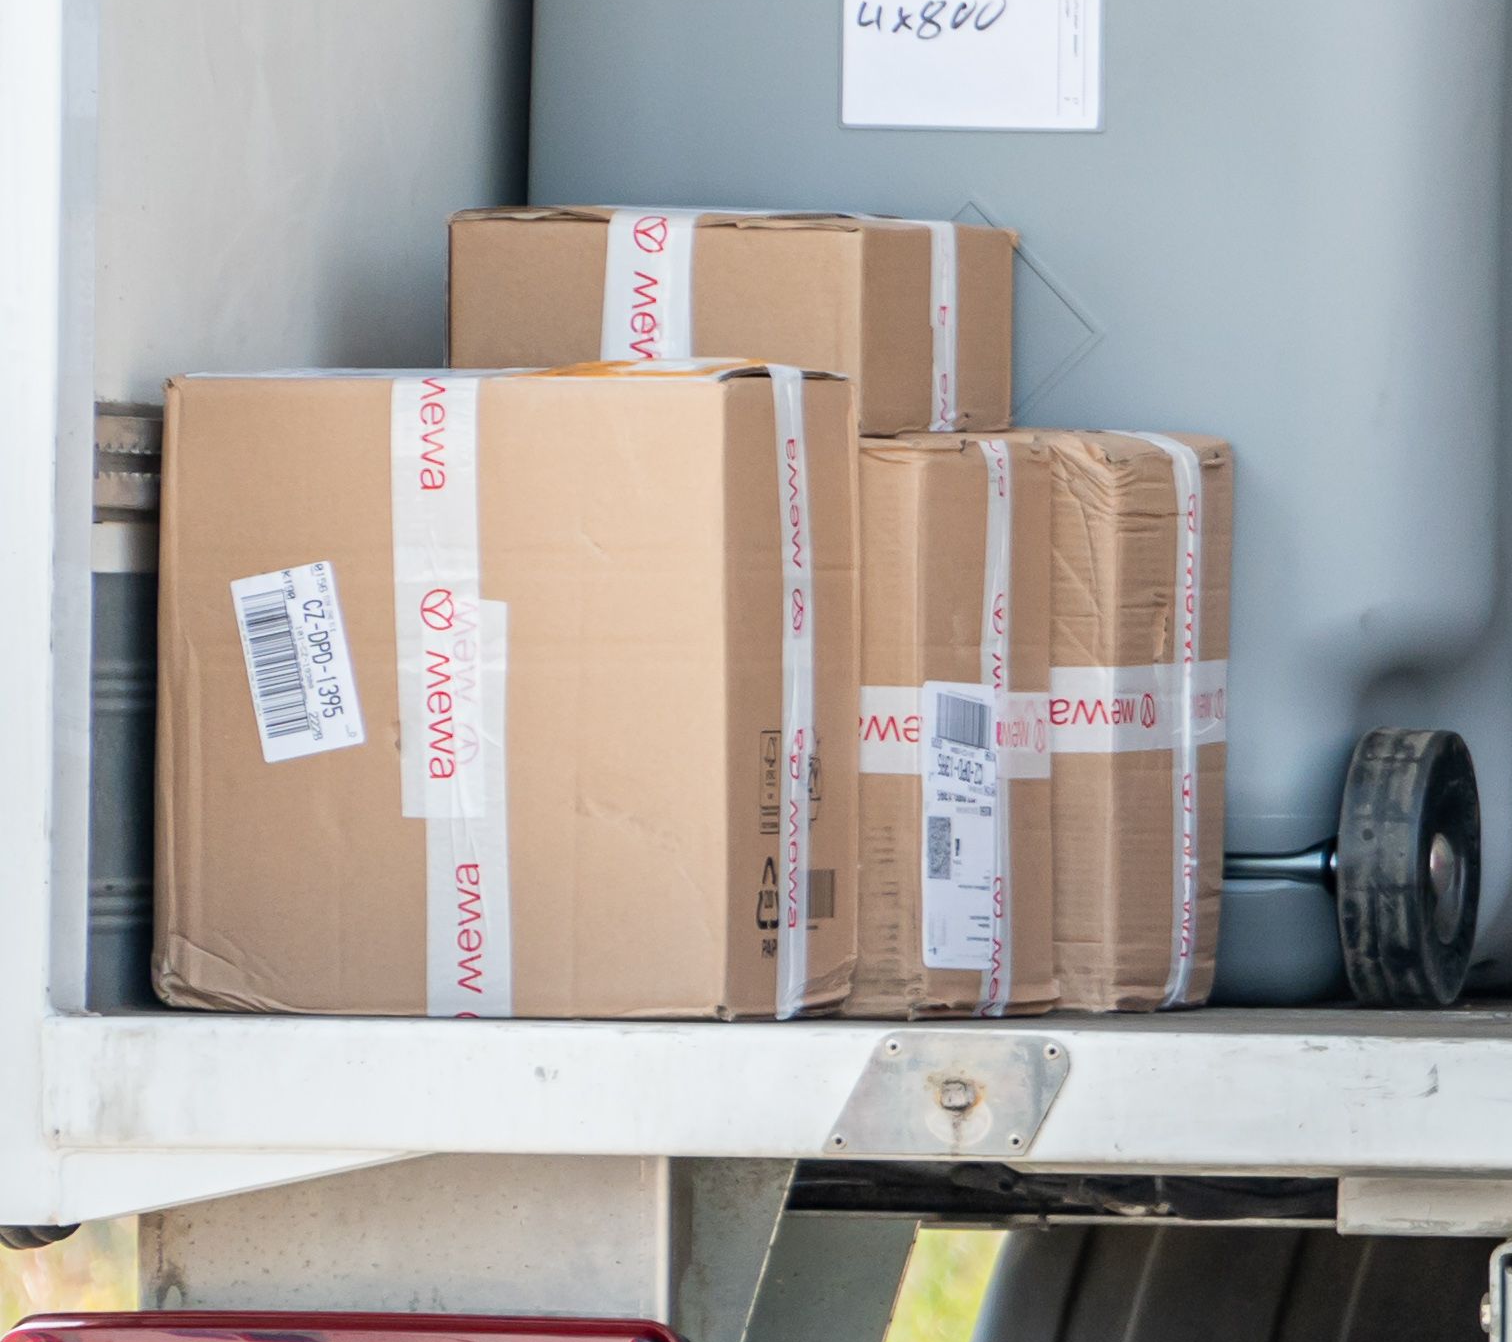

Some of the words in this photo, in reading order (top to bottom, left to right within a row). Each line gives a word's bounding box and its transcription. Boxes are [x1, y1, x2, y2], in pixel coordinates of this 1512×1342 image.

[303, 598, 345, 719] CZ-DPD-1395
[425, 649, 455, 780] mewa
[455, 863, 484, 995] mewa
